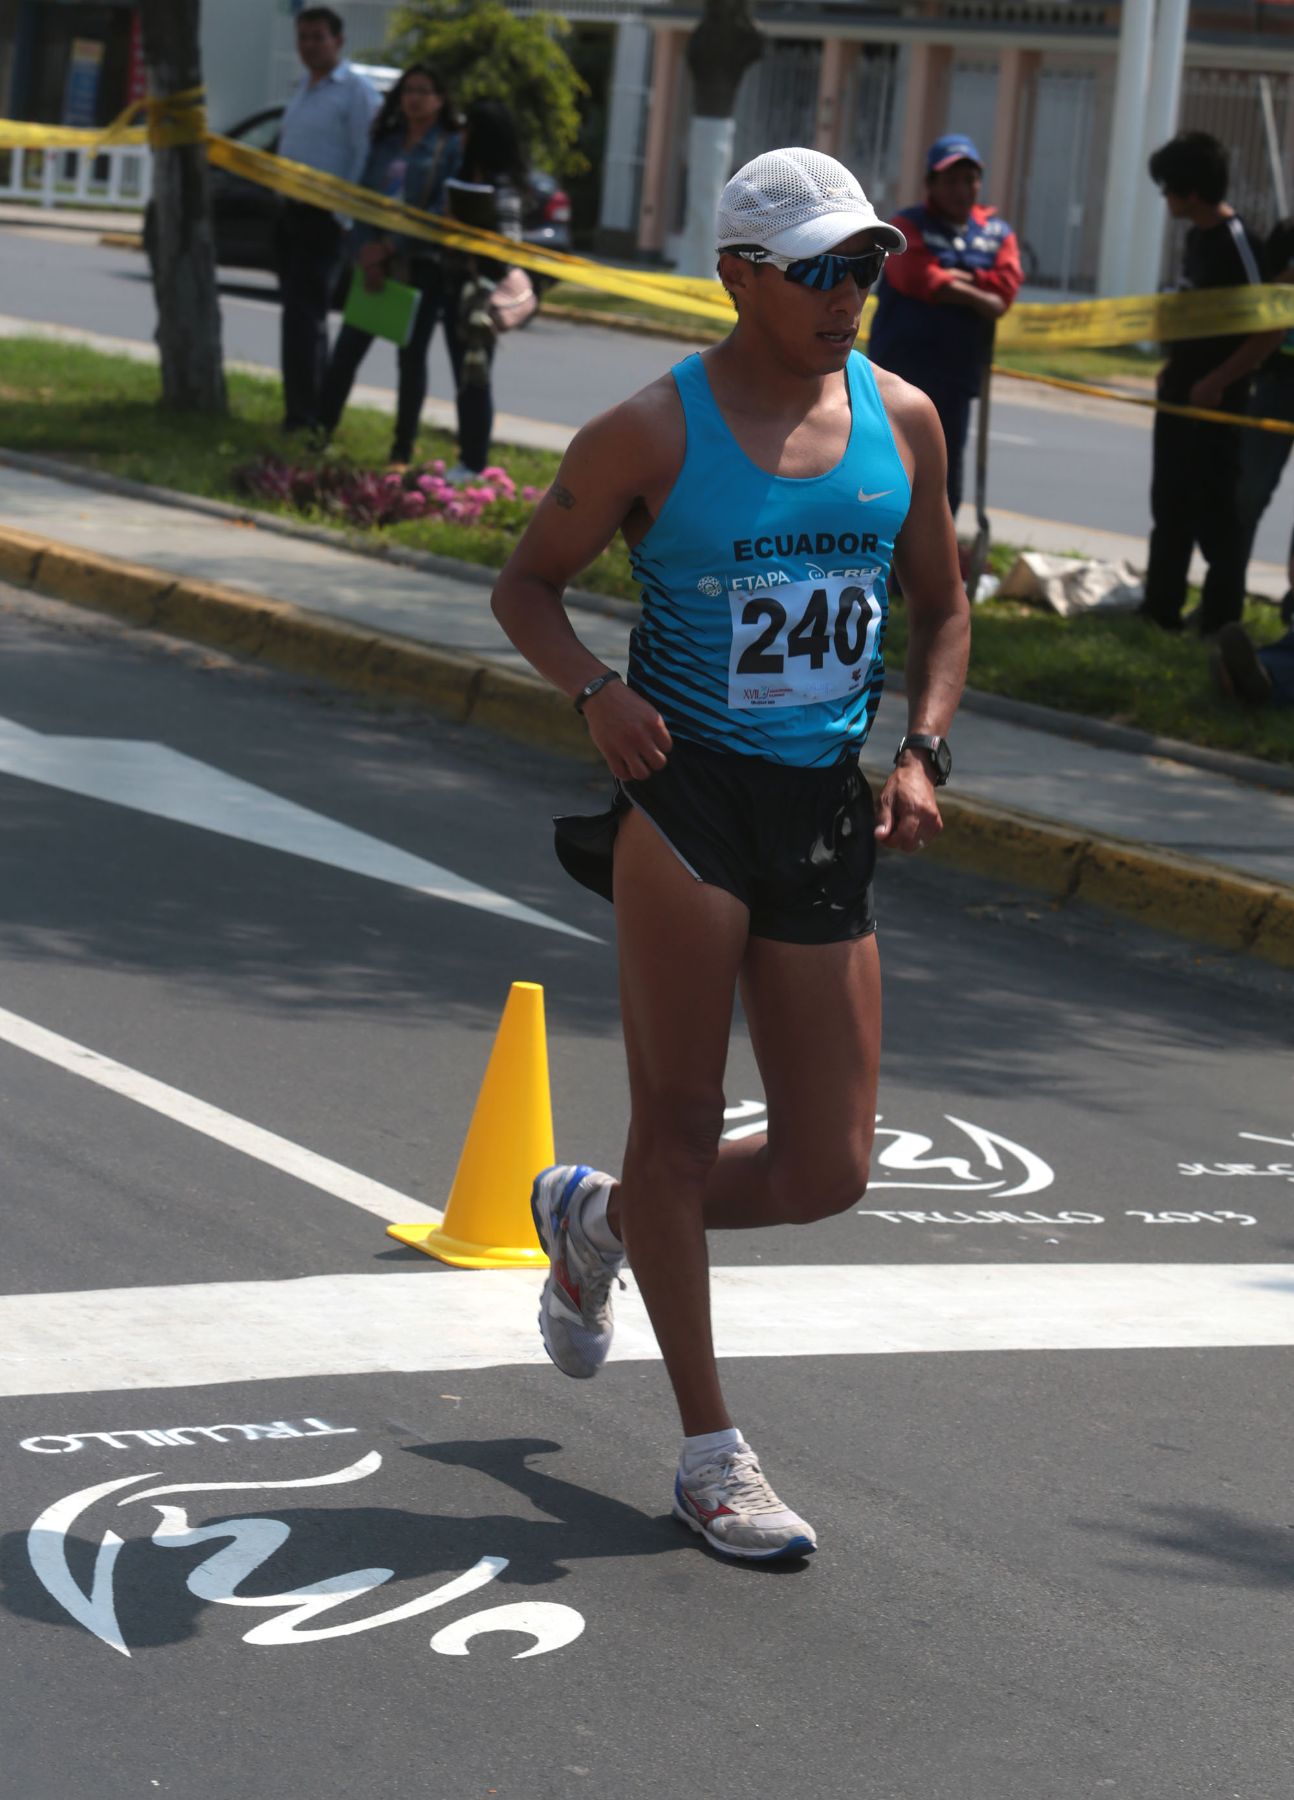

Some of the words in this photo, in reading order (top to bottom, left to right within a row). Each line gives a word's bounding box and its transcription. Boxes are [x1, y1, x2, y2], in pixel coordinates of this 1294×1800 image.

[733, 532, 878, 562] ECUADOR
[732, 569, 791, 591] ETAPA
[736, 586, 873, 675] 240
[857, 1210, 1105, 1224] TRUJILLO
[1125, 1210, 1257, 1225] 2013
[20, 1417, 357, 1454] TRUJILLO
